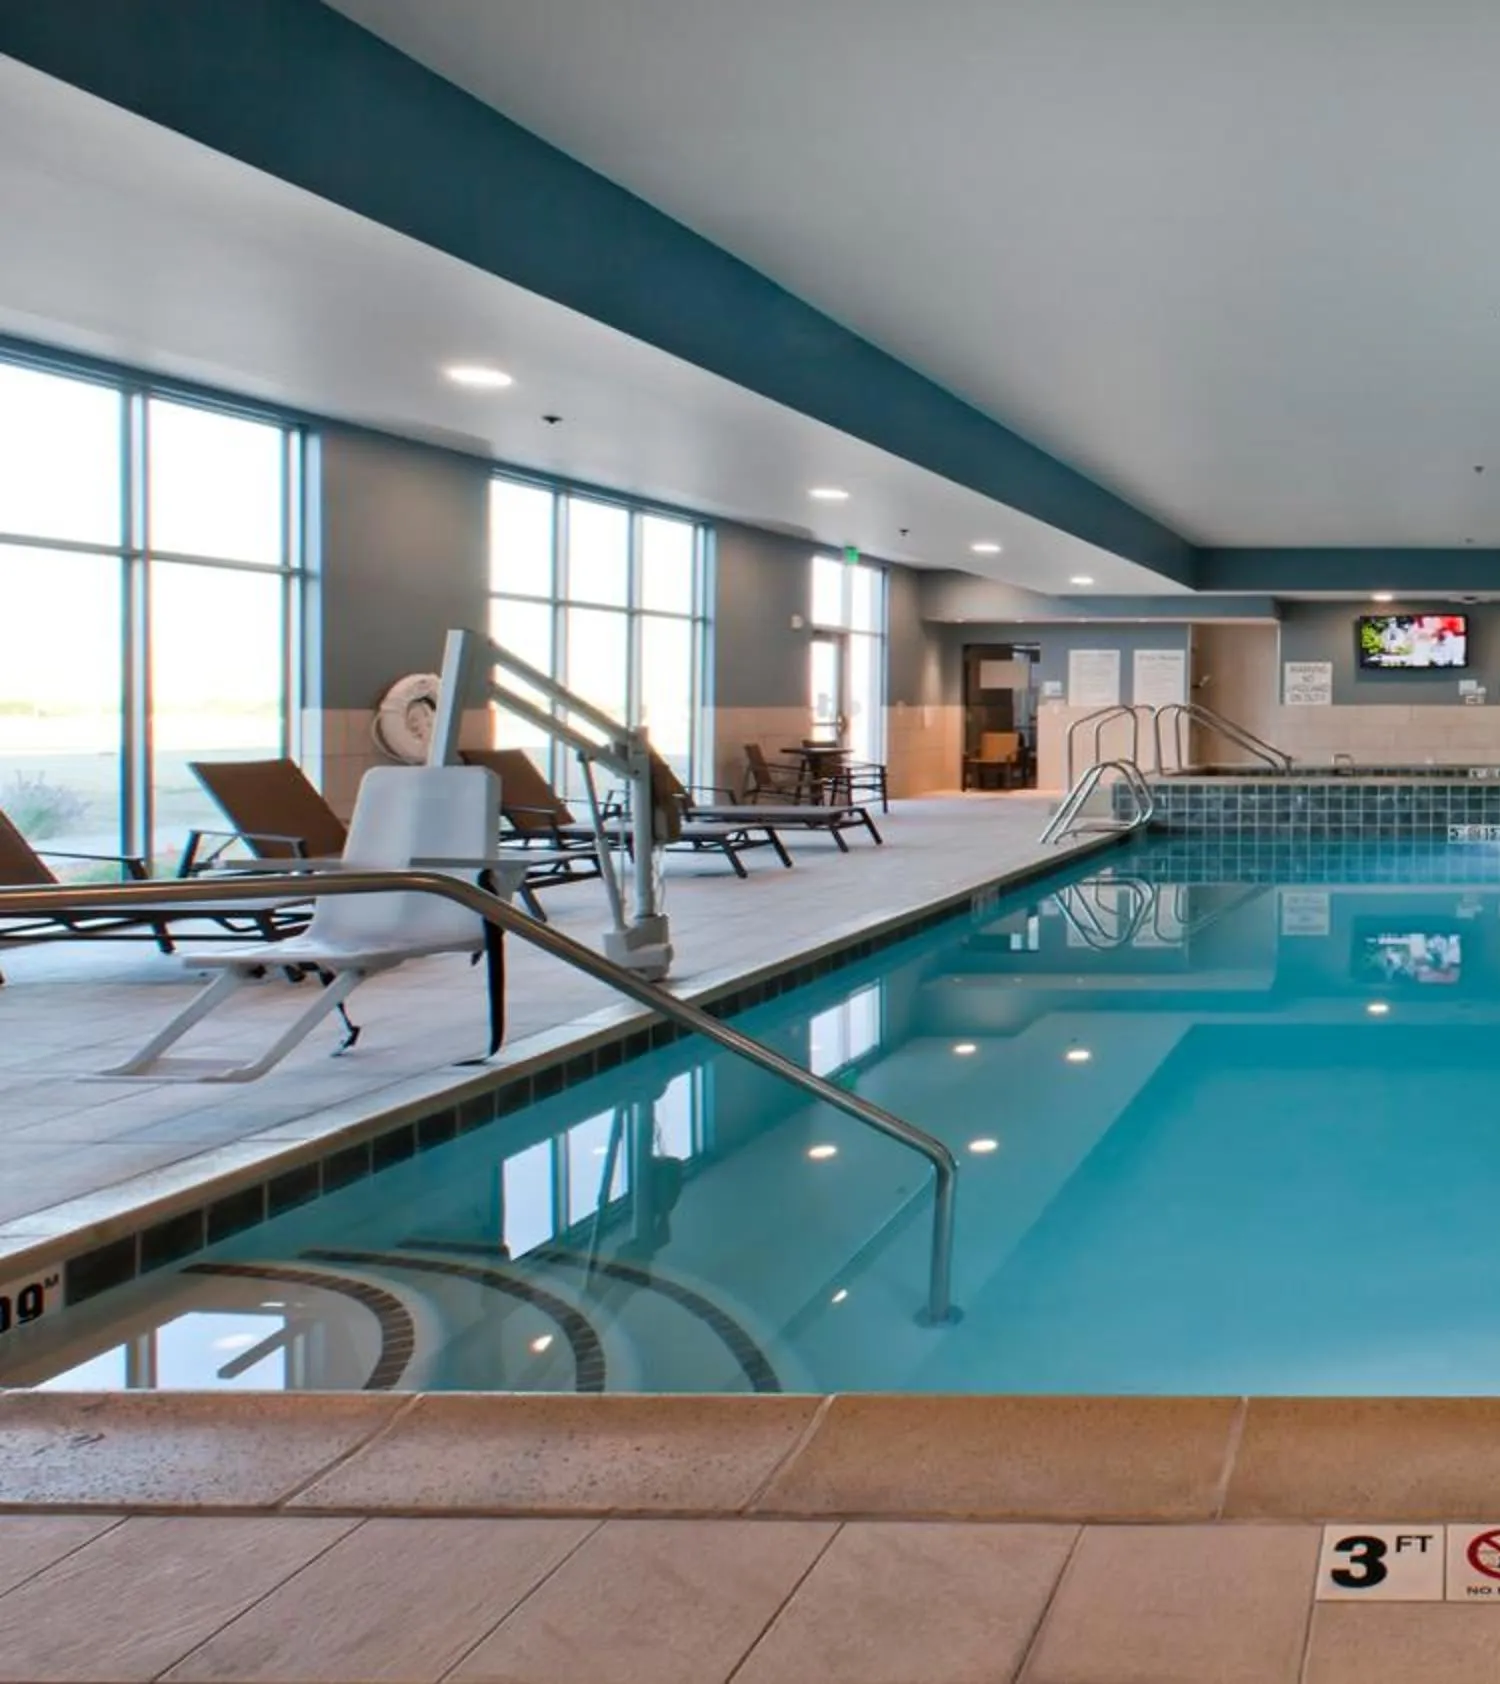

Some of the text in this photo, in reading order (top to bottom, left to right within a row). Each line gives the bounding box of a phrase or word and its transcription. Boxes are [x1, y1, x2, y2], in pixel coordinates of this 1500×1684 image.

[1331, 1535, 1434, 1588] 3 FT
[1466, 1586, 1492, 1596] NO
